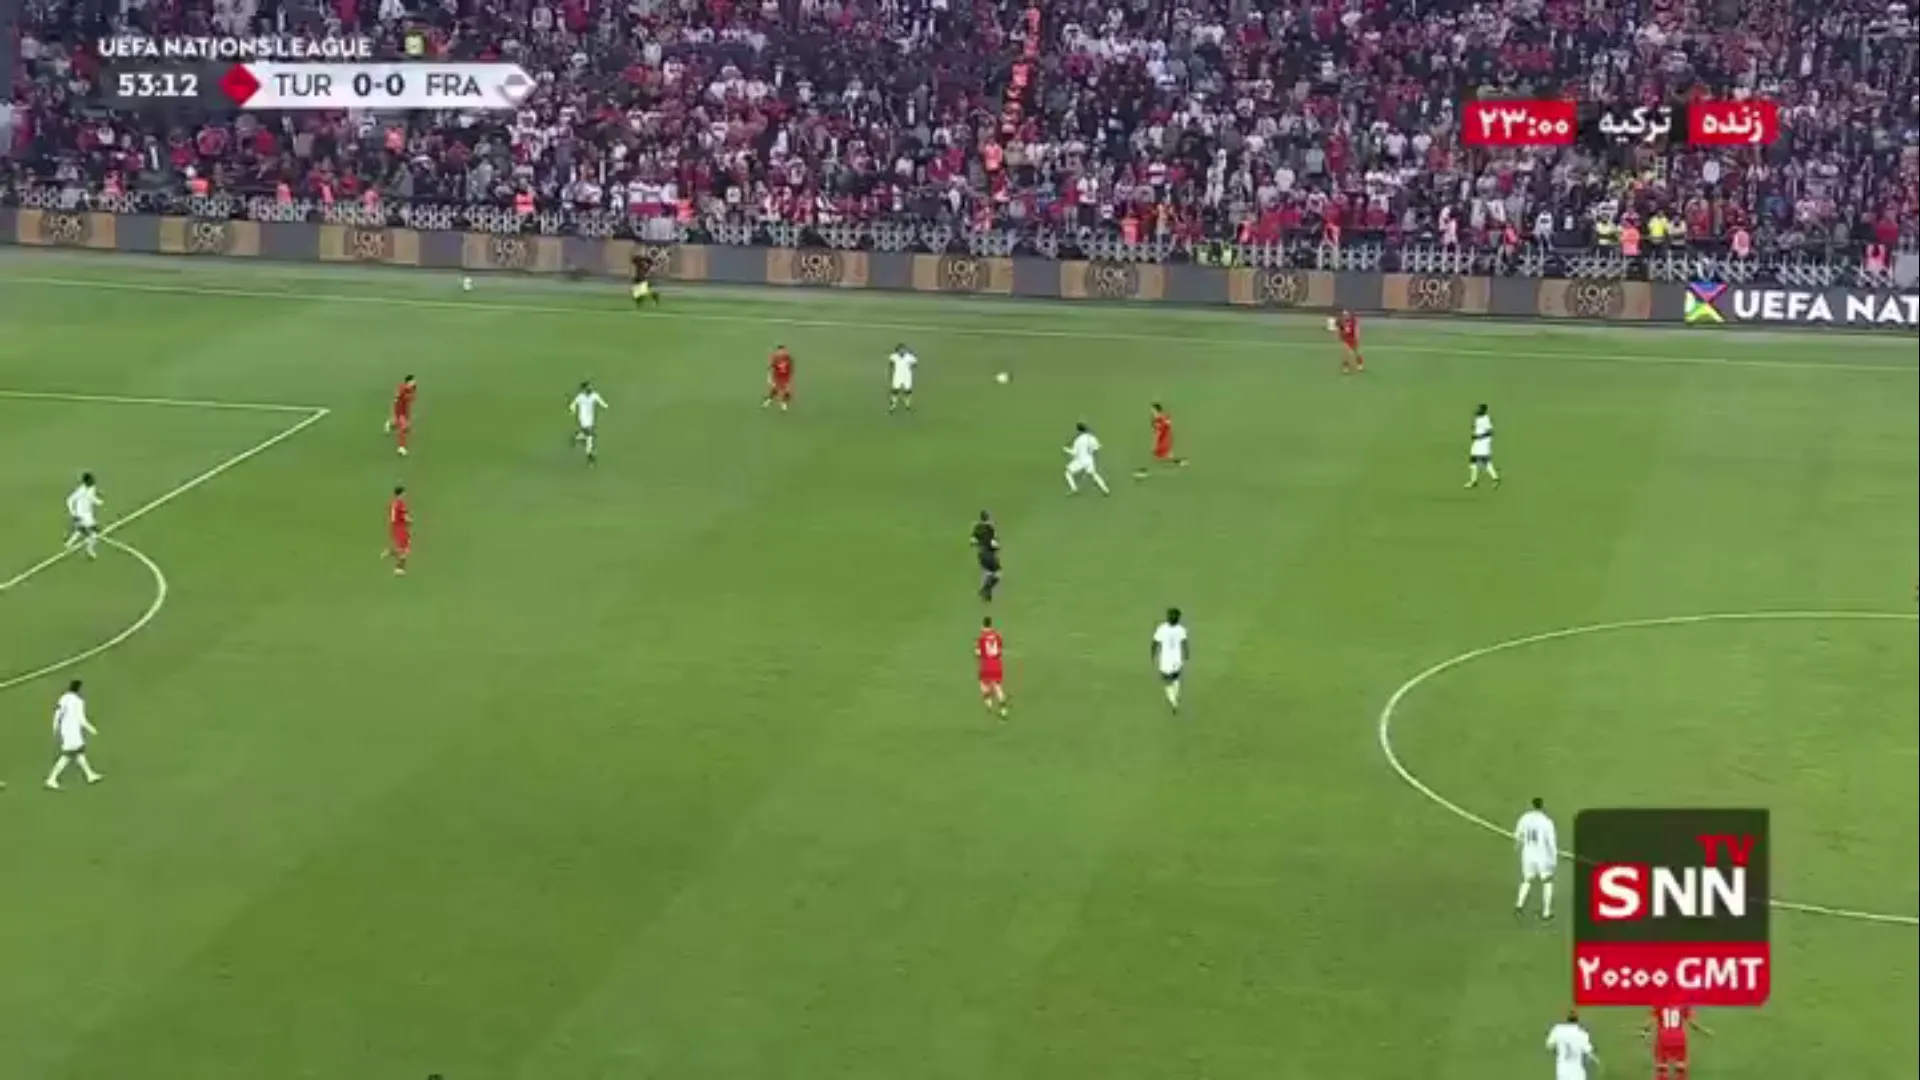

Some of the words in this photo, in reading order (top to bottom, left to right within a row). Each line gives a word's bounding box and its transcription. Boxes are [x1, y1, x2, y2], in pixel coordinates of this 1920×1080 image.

[802, 255, 833, 269] LOK
[1577, 284, 1611, 300] LOK
[1733, 291, 1833, 321] UEFA
[1662, 1007, 1681, 1029] 10
